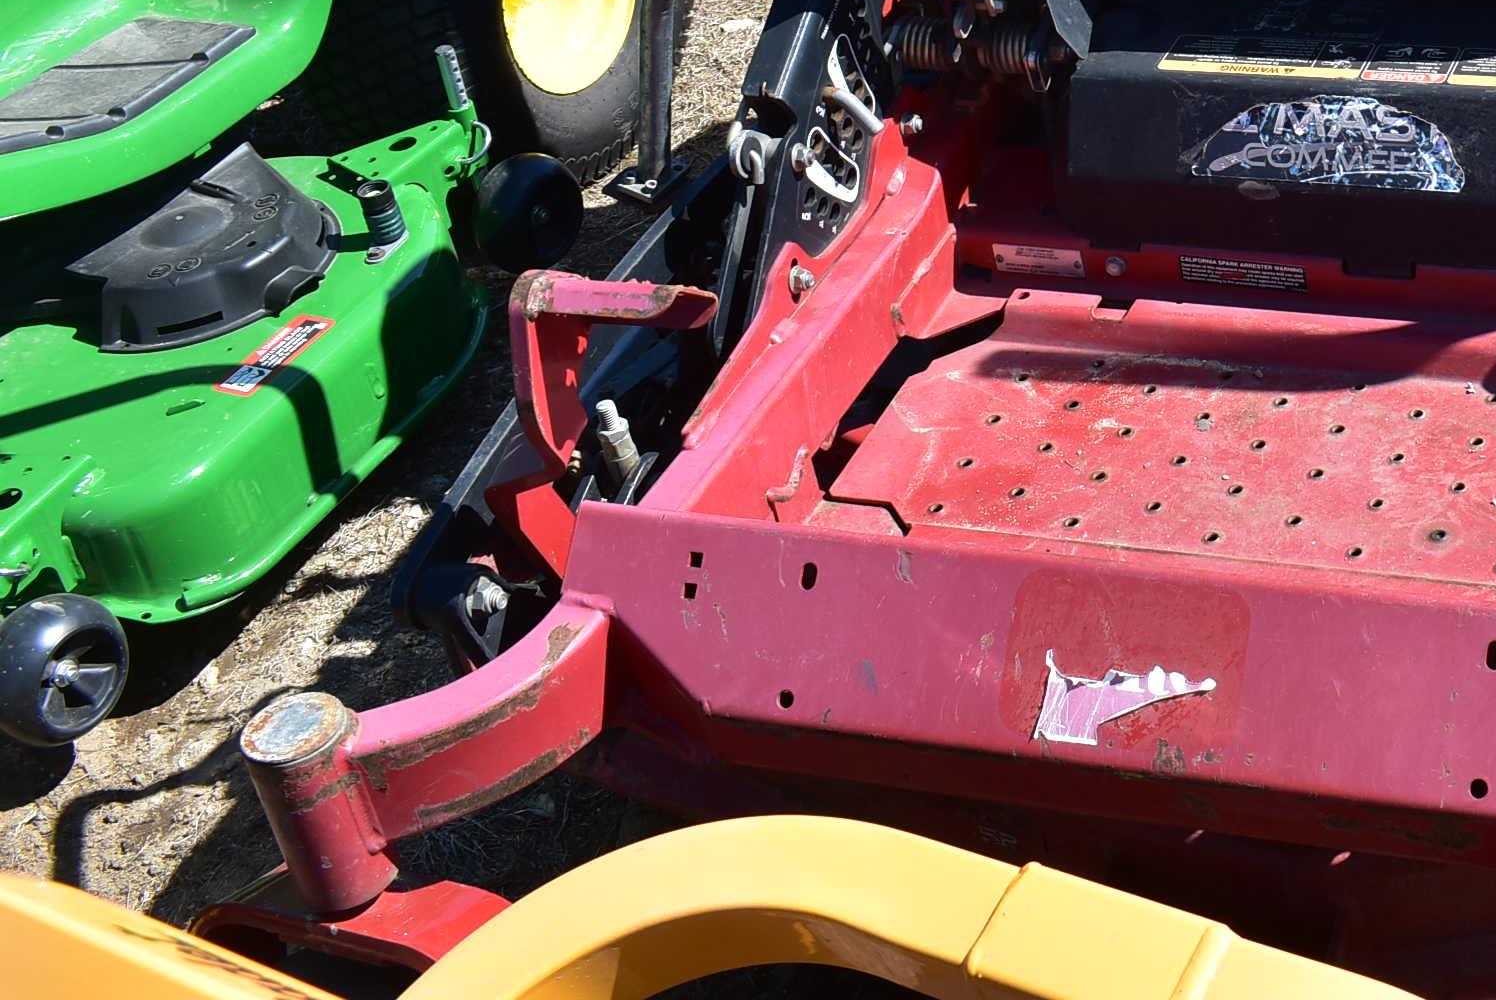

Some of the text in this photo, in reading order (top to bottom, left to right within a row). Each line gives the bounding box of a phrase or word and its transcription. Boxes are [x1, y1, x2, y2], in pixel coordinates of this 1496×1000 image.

[1219, 64, 1281, 75] WARNING
[1368, 72, 1428, 83] DANGER
[1273, 103, 1438, 143] MAS
[1180, 255, 1218, 265] CALIFORNIA
[1239, 262, 1273, 270] ARRESTER
[1273, 265, 1303, 273] WARNING
